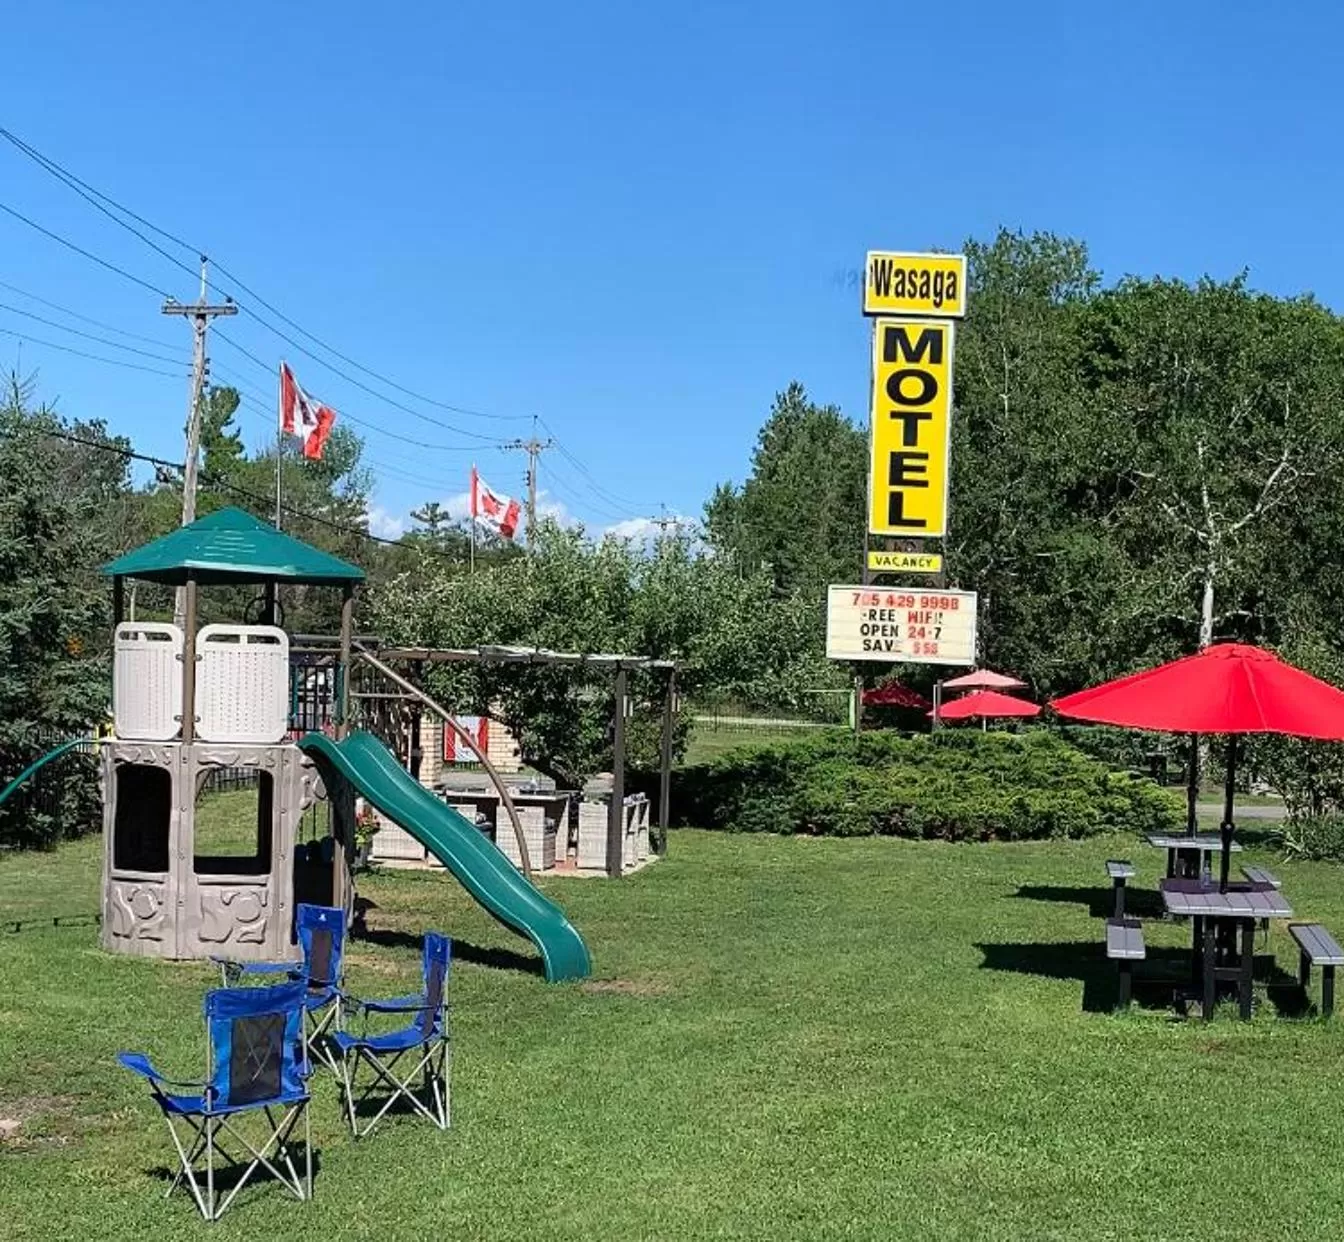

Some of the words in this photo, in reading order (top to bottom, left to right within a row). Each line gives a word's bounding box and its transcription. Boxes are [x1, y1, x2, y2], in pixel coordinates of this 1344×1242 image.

[873, 258, 957, 309] Wasaga
[883, 326, 944, 528] MOTEL
[875, 555, 932, 568] VACANCY
[886, 594, 915, 608] 429
[862, 608, 896, 622] REE
[860, 623, 899, 637] OPEN
